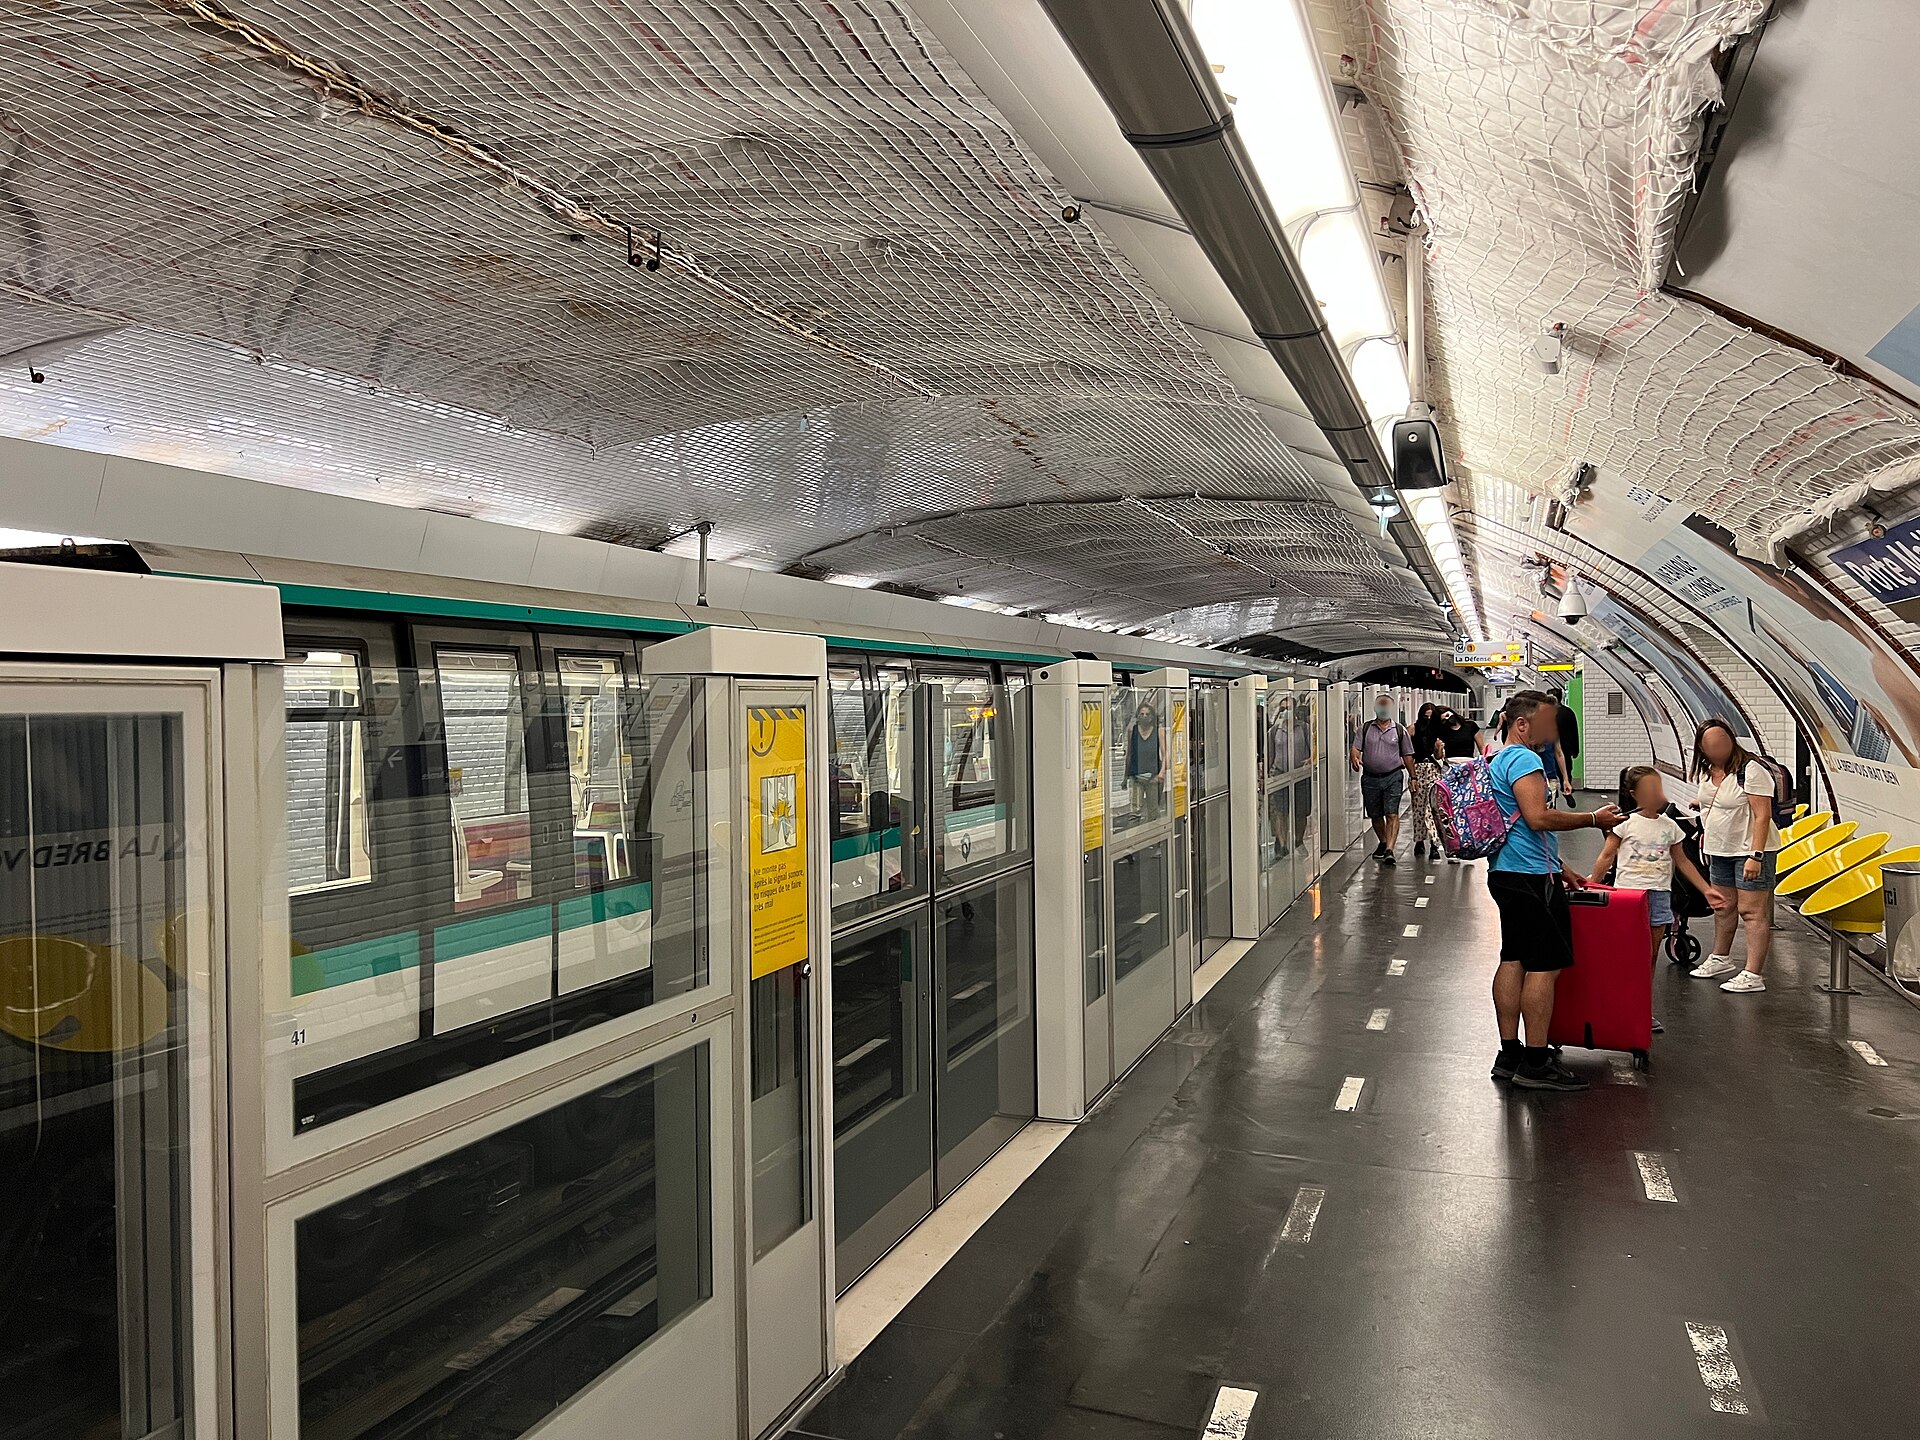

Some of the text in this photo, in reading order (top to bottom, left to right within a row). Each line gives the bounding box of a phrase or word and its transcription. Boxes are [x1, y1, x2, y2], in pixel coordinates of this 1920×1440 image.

[1844, 554, 1917, 593] Porte
[753, 863, 786, 876] Ne monte pas
[754, 878, 767, 890] après
[768, 876, 773, 885] le
[774, 872, 787, 884] signal
[760, 888, 777, 898] risques
[778, 884, 785, 893] de
[785, 883, 791, 891] te
[791, 881, 801, 889] faire
[765, 899, 773, 908] mal
[291, 1029, 306, 1046] 41
